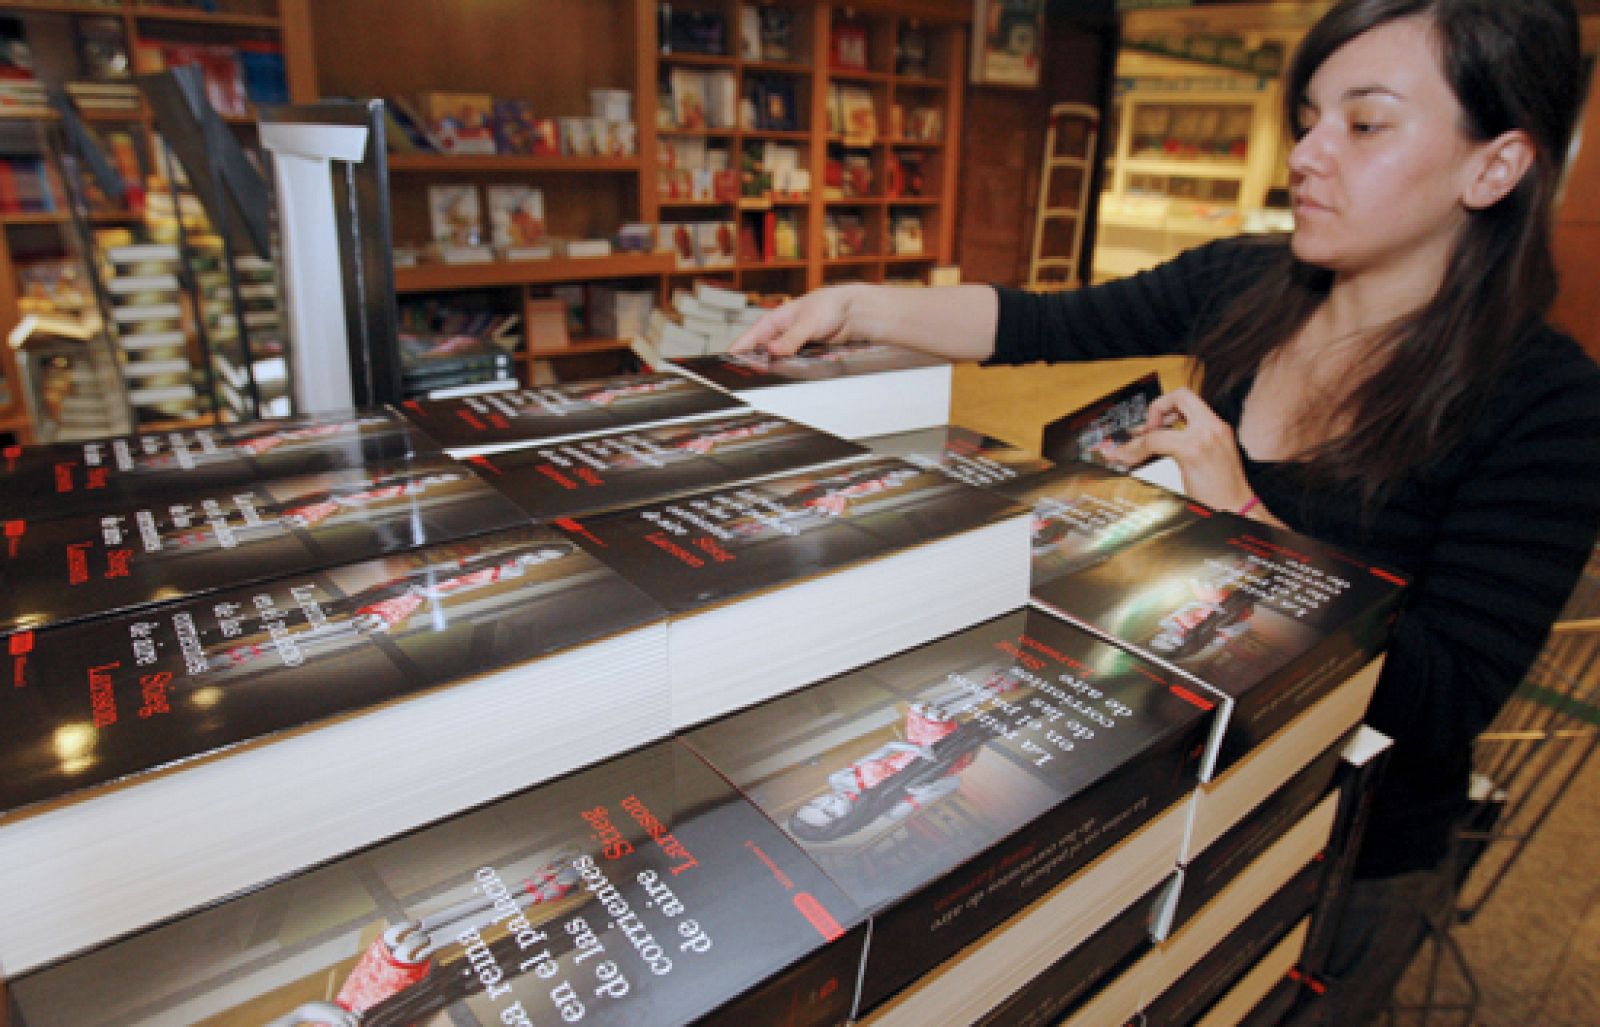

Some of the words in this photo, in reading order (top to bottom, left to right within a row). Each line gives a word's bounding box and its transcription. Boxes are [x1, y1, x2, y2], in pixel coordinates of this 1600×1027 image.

[580, 805, 636, 860] Stieg
[620, 794, 699, 877] Larsson
[473, 866, 549, 950] palacio
[572, 854, 673, 976] corrientes
[636, 869, 685, 918] aire
[564, 917, 606, 966] las
[677, 918, 714, 953] de
[457, 926, 512, 1001] reina
[519, 947, 560, 980] el
[593, 959, 630, 999] de
[549, 979, 586, 1023] en
